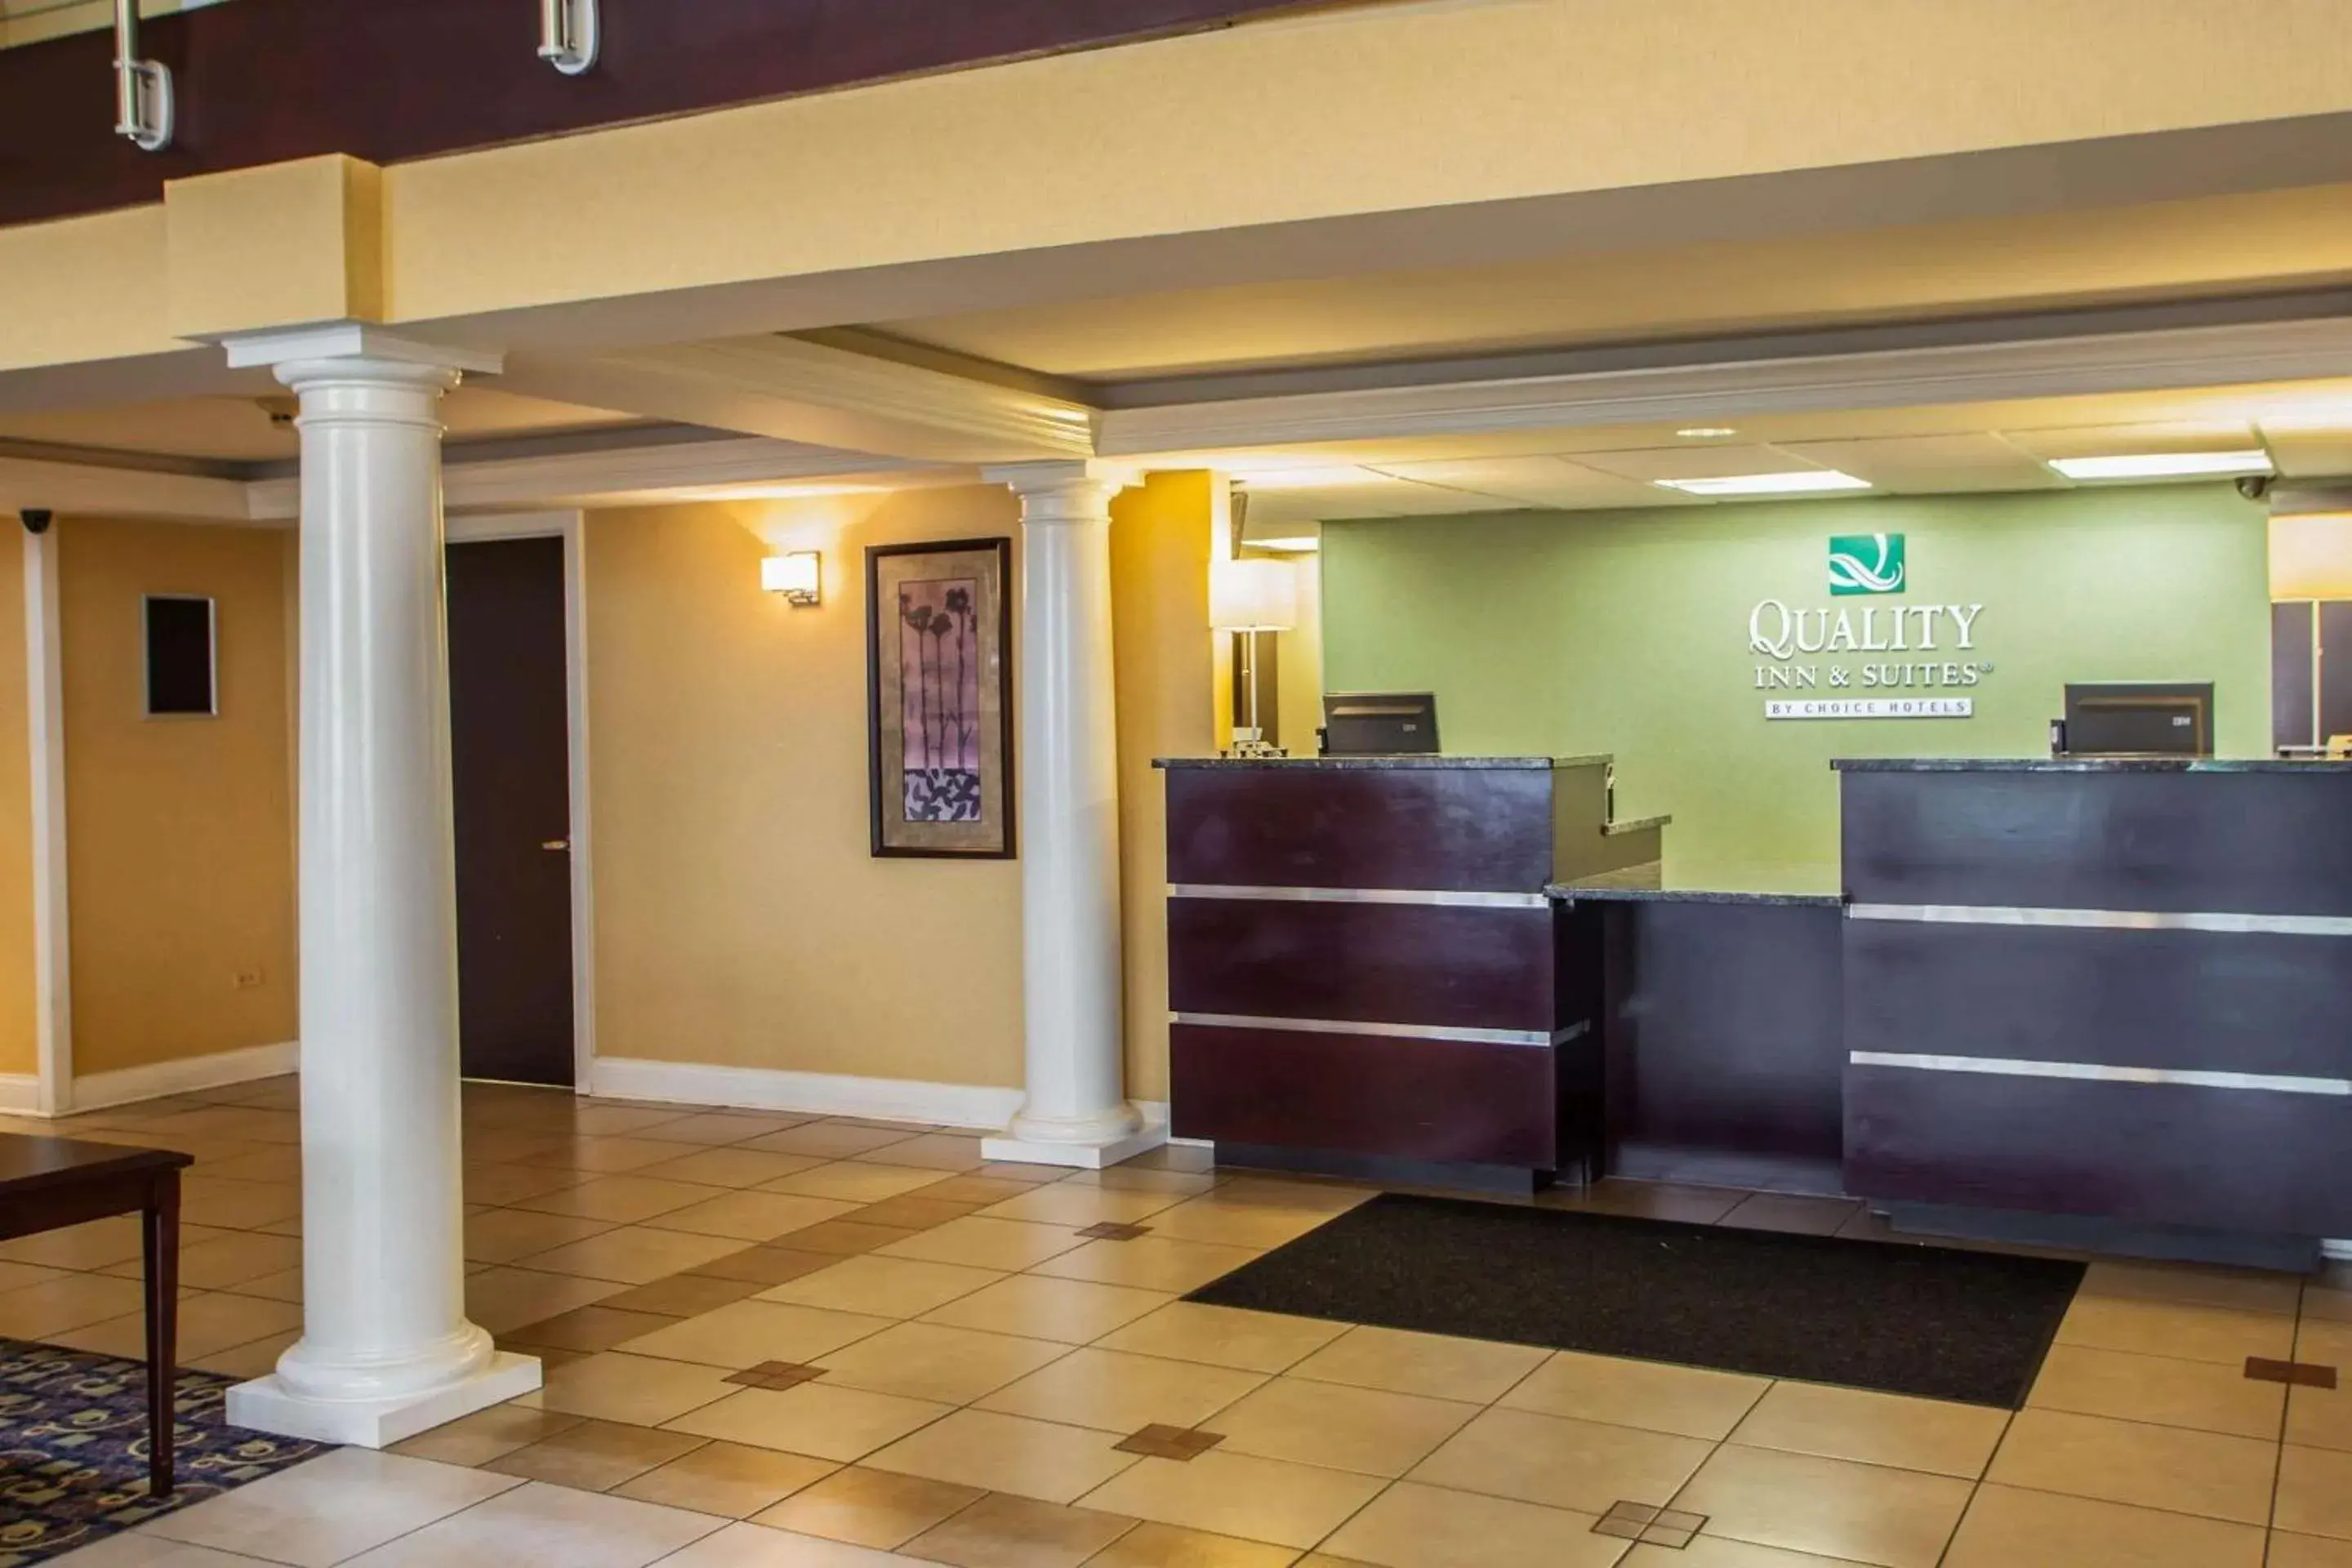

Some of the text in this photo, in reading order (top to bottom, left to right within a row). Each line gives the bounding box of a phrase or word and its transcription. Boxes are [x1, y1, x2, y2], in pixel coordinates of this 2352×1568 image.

[1748, 599, 1982, 660] QUALITY
[1755, 666, 1817, 688] INN
[1829, 666, 1849, 687] &
[1772, 702, 1966, 714] BY CHOICE HOTELS
